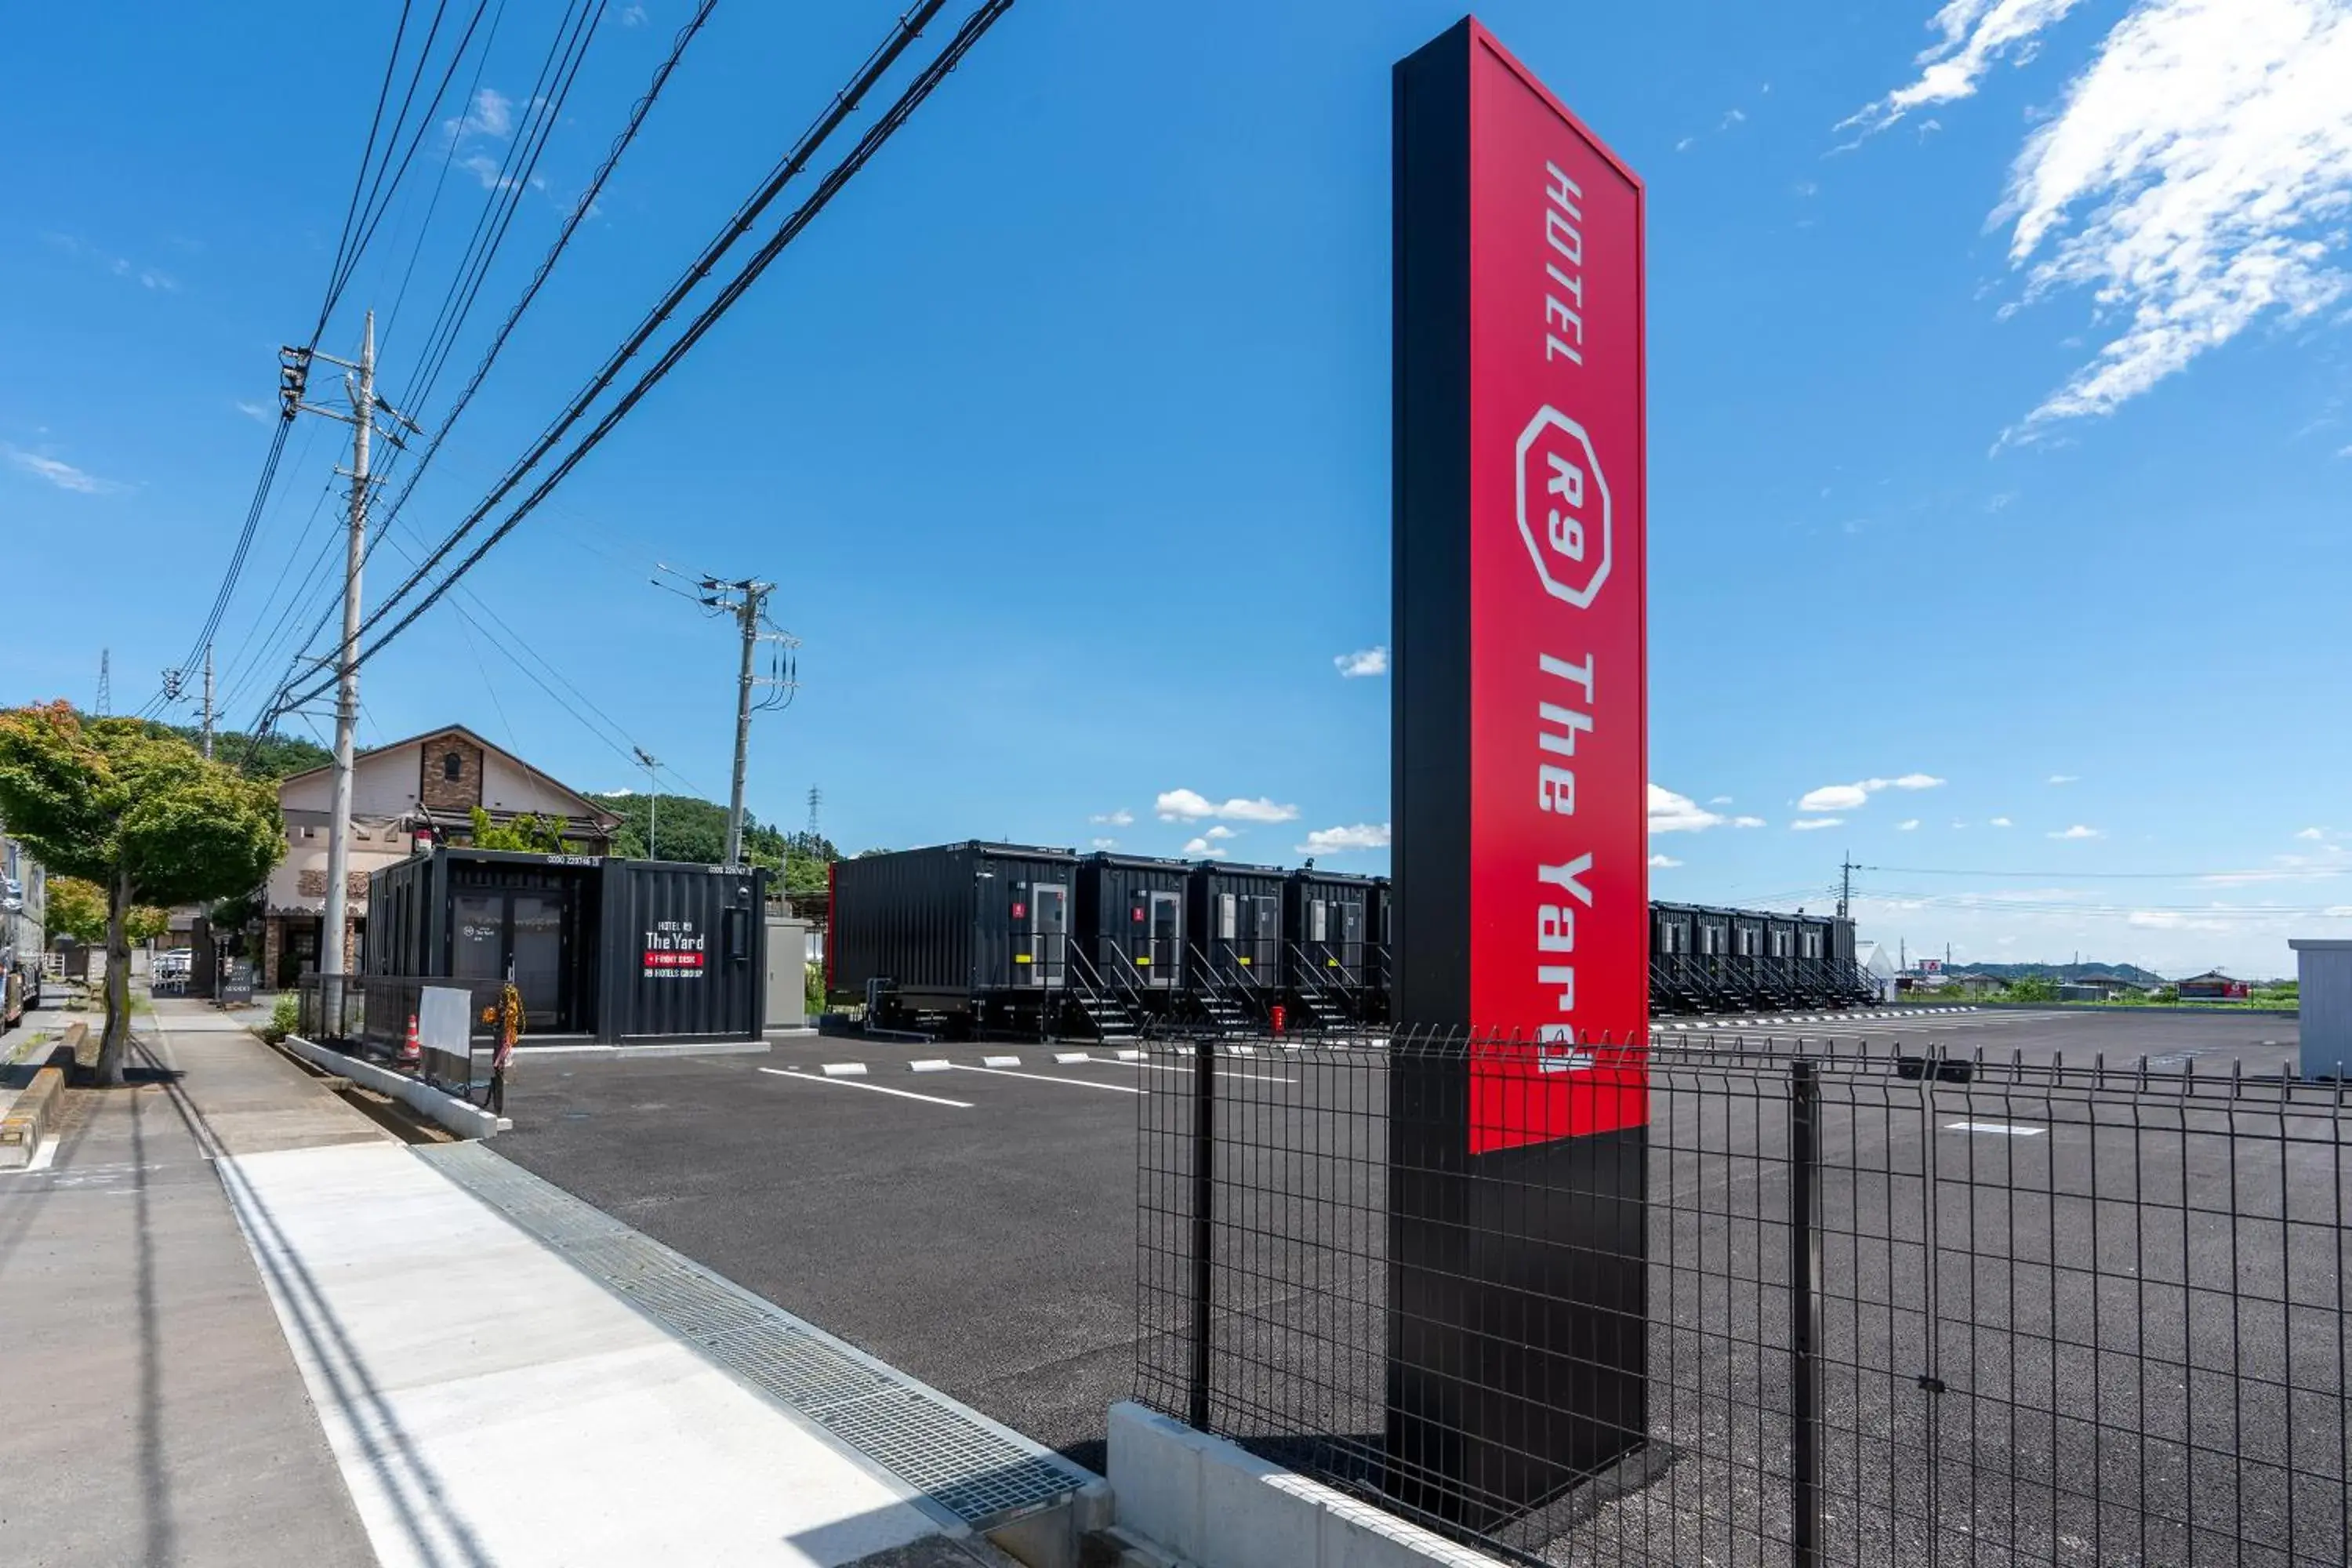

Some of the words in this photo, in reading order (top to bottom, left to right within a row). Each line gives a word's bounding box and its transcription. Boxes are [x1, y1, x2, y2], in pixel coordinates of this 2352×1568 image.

[1546, 160, 1583, 367] HOTEL
[1547, 451, 1584, 562] R9
[1538, 652, 1594, 816] The
[645, 932, 671, 949] The
[672, 932, 705, 950] Yard
[658, 921, 681, 931] HOTEL
[1537, 852, 1595, 1073] Yard
